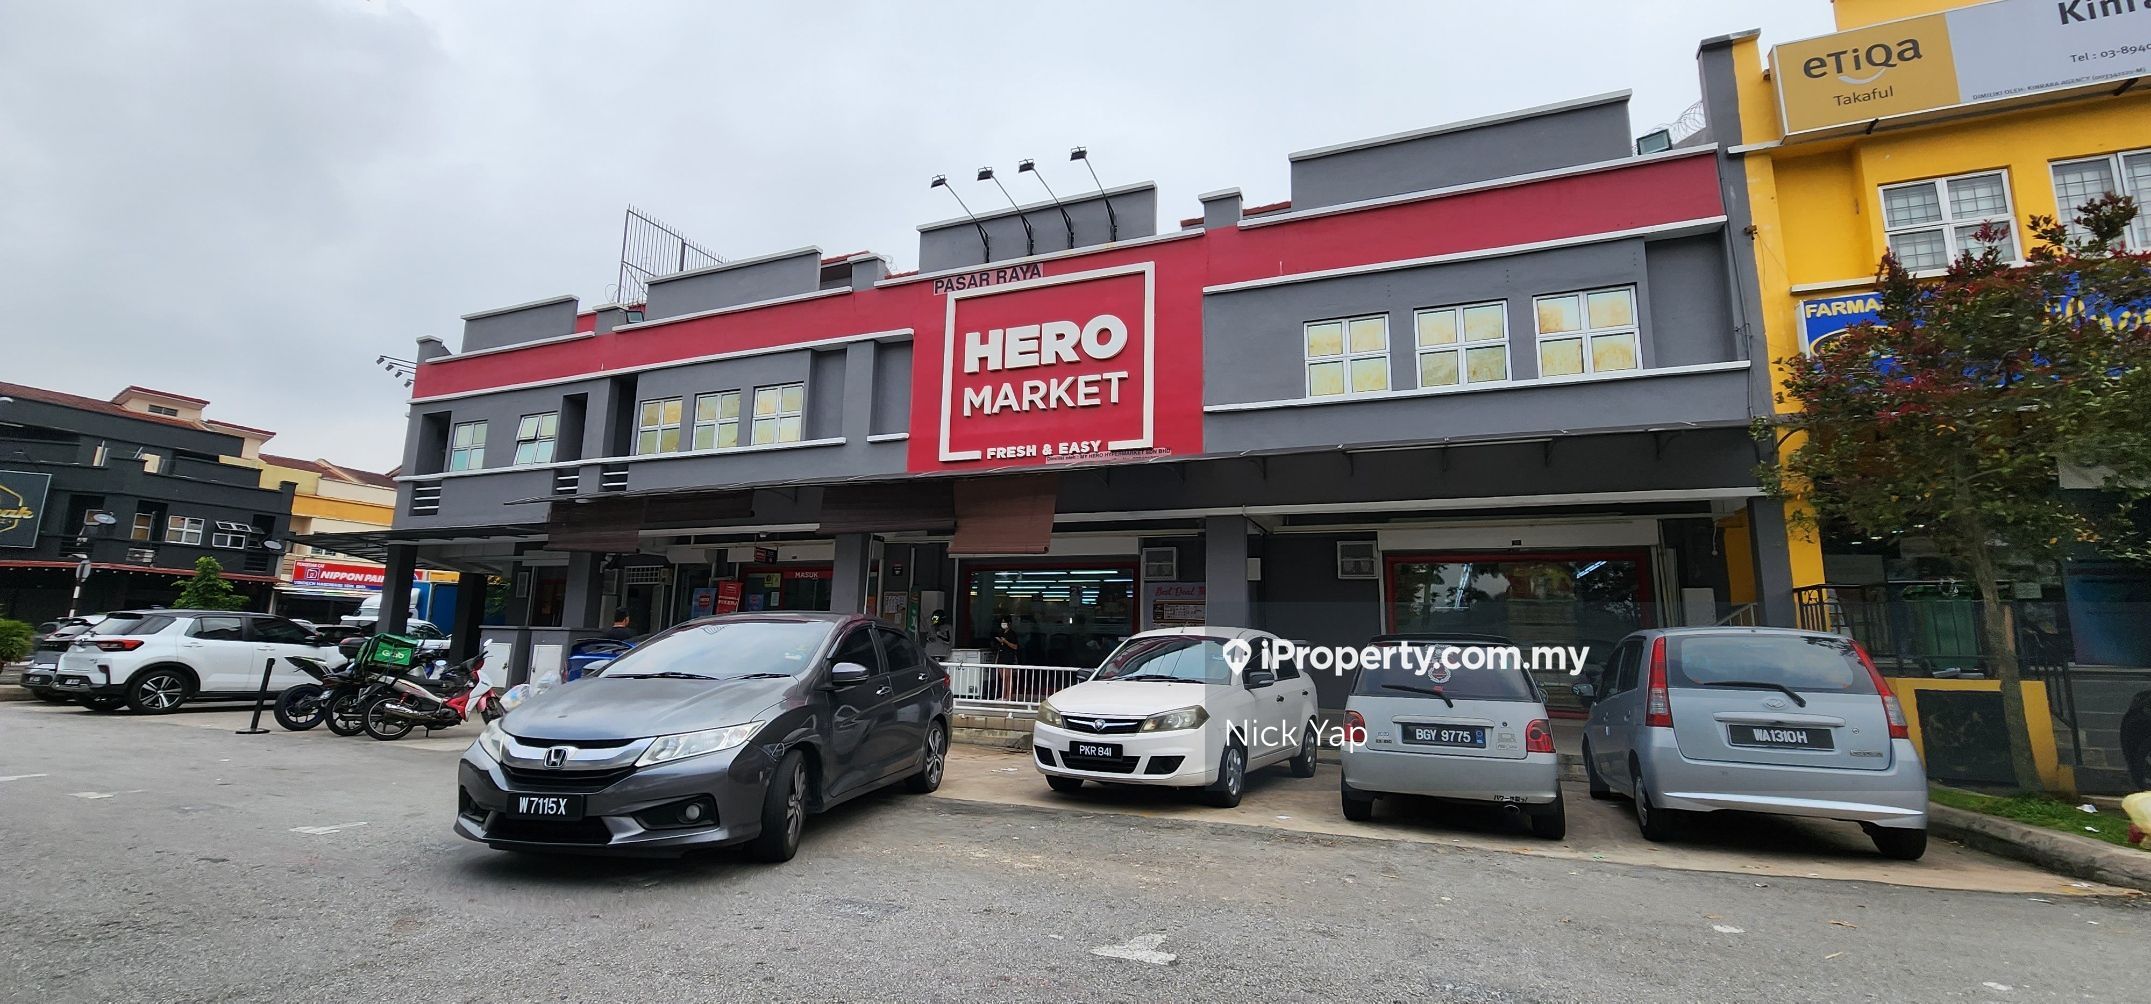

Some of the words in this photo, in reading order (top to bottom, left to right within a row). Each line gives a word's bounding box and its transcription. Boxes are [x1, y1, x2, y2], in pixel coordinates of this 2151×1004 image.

[2070, 52, 2089, 63] Tel
[1833, 85, 1894, 106] Takaful
[934, 272, 990, 294] PASAR
[996, 263, 1042, 285] RAYA
[1805, 297, 1884, 318] FARMA
[964, 314, 1128, 374] HERO
[963, 371, 1129, 417] MARKET
[986, 444, 1037, 460] FRESH
[1042, 443, 1053, 456] &
[1059, 440, 1102, 455] EASY
[320, 570, 364, 582] NIPPON
[795, 571, 819, 579] MASUK
[1415, 728, 1437, 741] BGY
[1441, 730, 1471, 743] 9775
[1753, 728, 1808, 744] WA1310H
[1079, 745, 1096, 756] PKR
[1098, 746, 1112, 757] 841
[519, 797, 567, 815] W7115X
